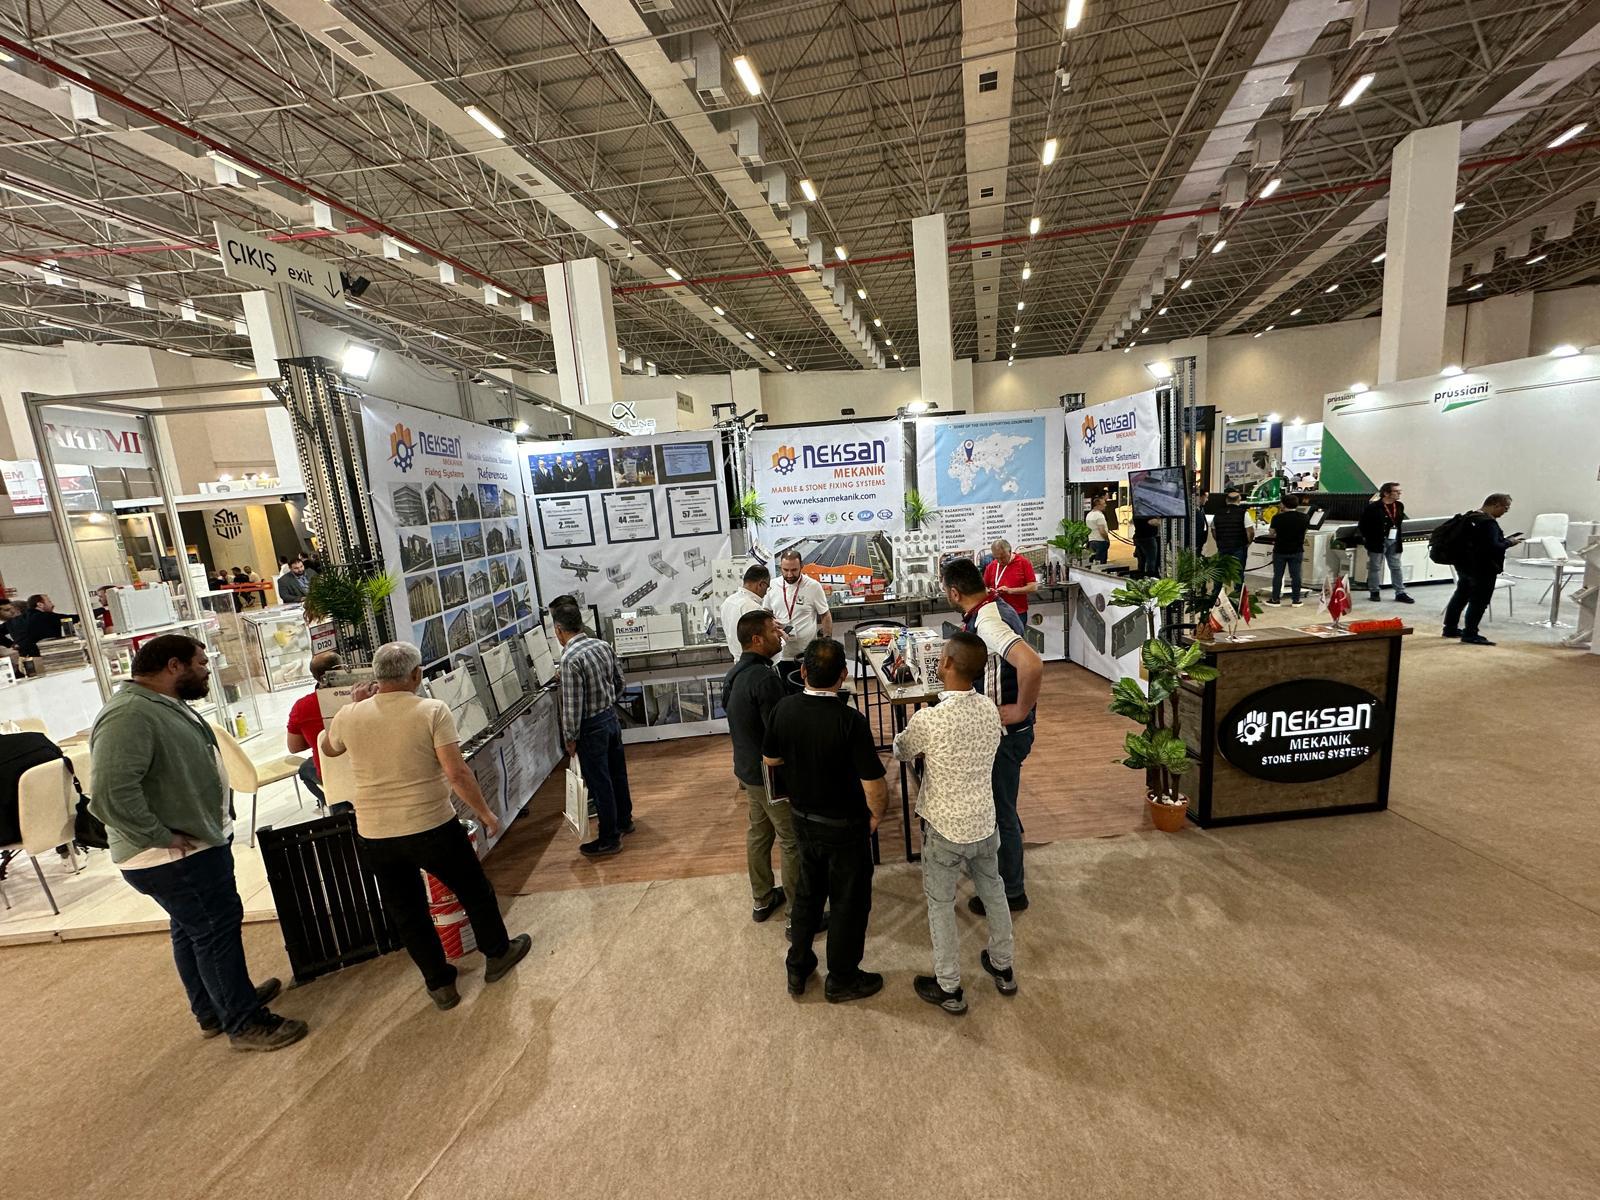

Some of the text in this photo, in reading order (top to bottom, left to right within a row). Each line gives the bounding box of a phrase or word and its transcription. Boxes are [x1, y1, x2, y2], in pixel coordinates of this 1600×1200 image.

[227, 240, 314, 286] ÇIKIŞ exit
[1327, 393, 1356, 404] prussiani
[1434, 382, 1489, 402] prussiani
[1226, 427, 1266, 443] BELT
[424, 467, 465, 479] Fixing Systems
[833, 465, 885, 479] MEKANİK
[1122, 462, 1141, 470] SYSTEMS
[477, 466, 508, 481] References
[771, 484, 798, 494] MARBLE
[805, 481, 827, 492] STONE
[829, 480, 854, 490] FIXING
[856, 478, 886, 488] SYSTEMS
[782, 492, 876, 506] www.neksanmekanik.com
[840, 511, 854, 521] CE
[317, 640, 332, 650] D120
[1290, 732, 1352, 750] MEKANİK
[1261, 754, 1292, 765] STONE
[1294, 751, 1326, 762] FIXING
